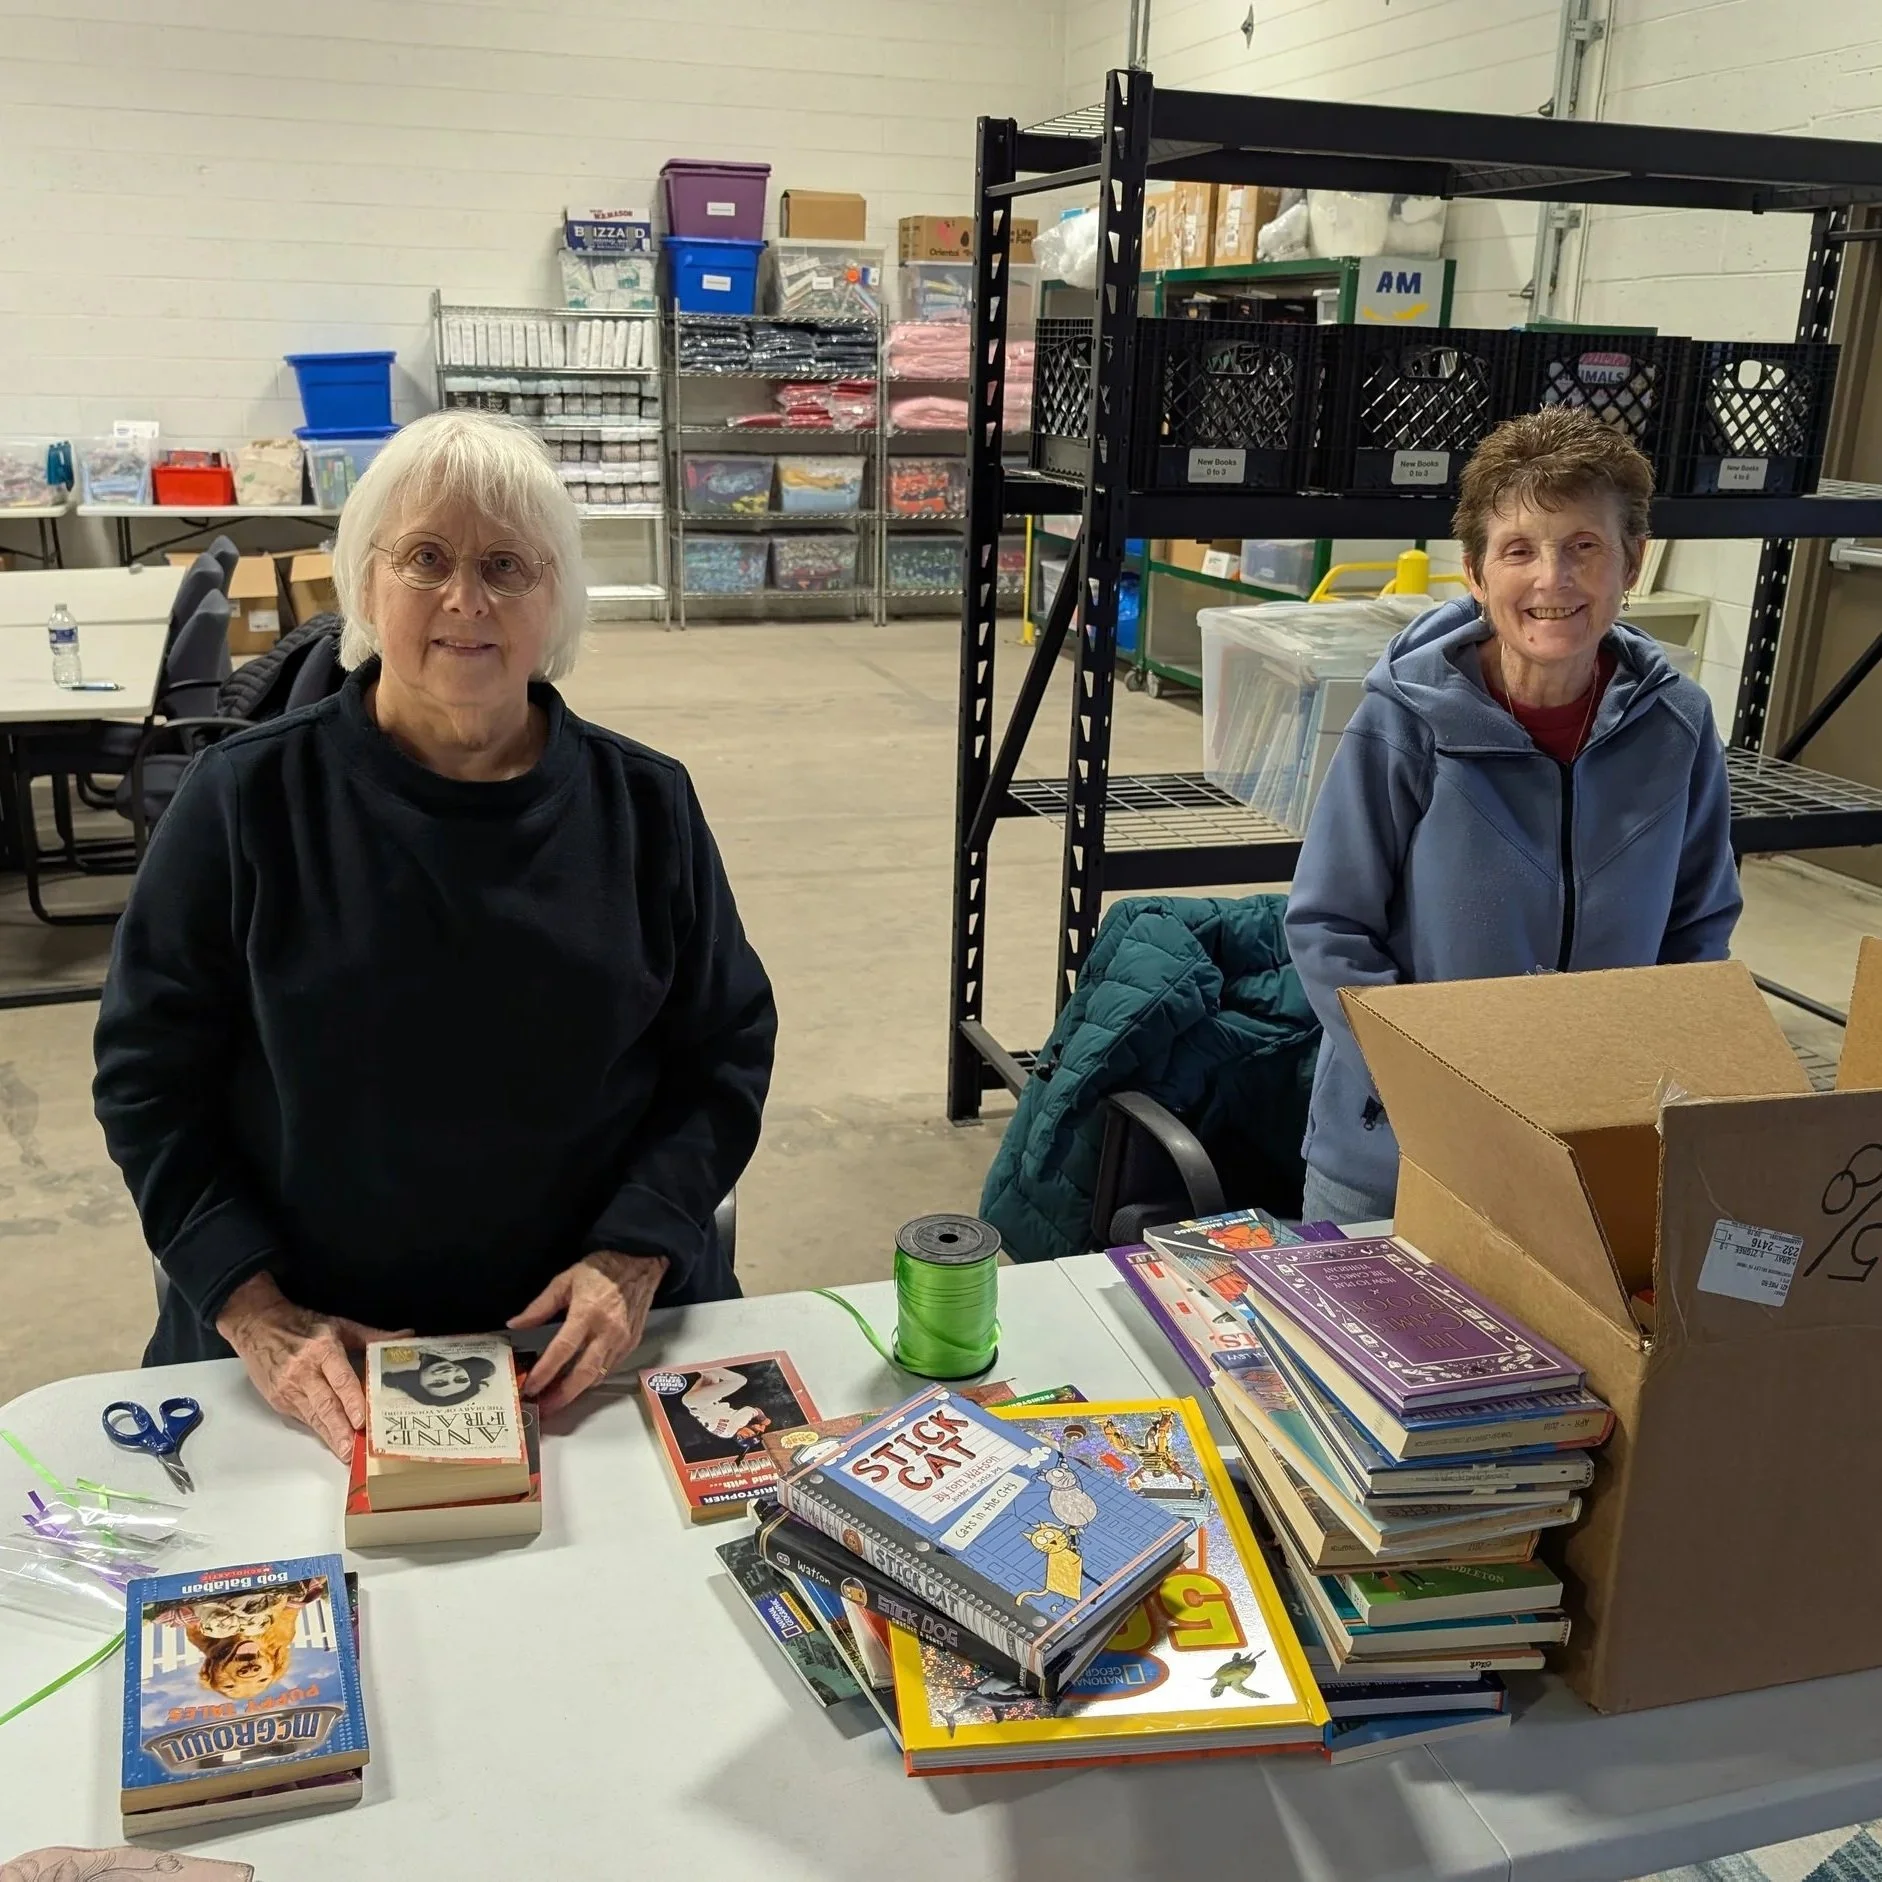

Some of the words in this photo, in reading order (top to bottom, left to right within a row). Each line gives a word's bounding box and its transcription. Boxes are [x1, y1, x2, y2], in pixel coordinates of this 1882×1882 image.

[574, 225, 645, 238] BIZZAD
[1376, 271, 1421, 294] AM
[1344, 1294, 1442, 1312] BOOK
[385, 1412, 505, 1428] FRANK
[386, 1426, 508, 1444] ANNE
[849, 1410, 969, 1484] STICK
[896, 1435, 977, 1492] CAT
[964, 1453, 1000, 1479] Watson
[955, 1517, 978, 1540] Cats
[974, 1510, 985, 1521] in
[983, 1494, 1001, 1512] the
[997, 1479, 1018, 1499] City
[182, 1577, 250, 1595] Balaban
[257, 1571, 287, 1585] Bob
[770, 1597, 794, 1627] GEOGRAPHIC
[795, 1559, 832, 1587] Watson
[921, 1616, 961, 1646] DOG
[768, 1606, 786, 1629] NATIONAL
[245, 1683, 319, 1714] PUPPY
[167, 1702, 237, 1723] TALES
